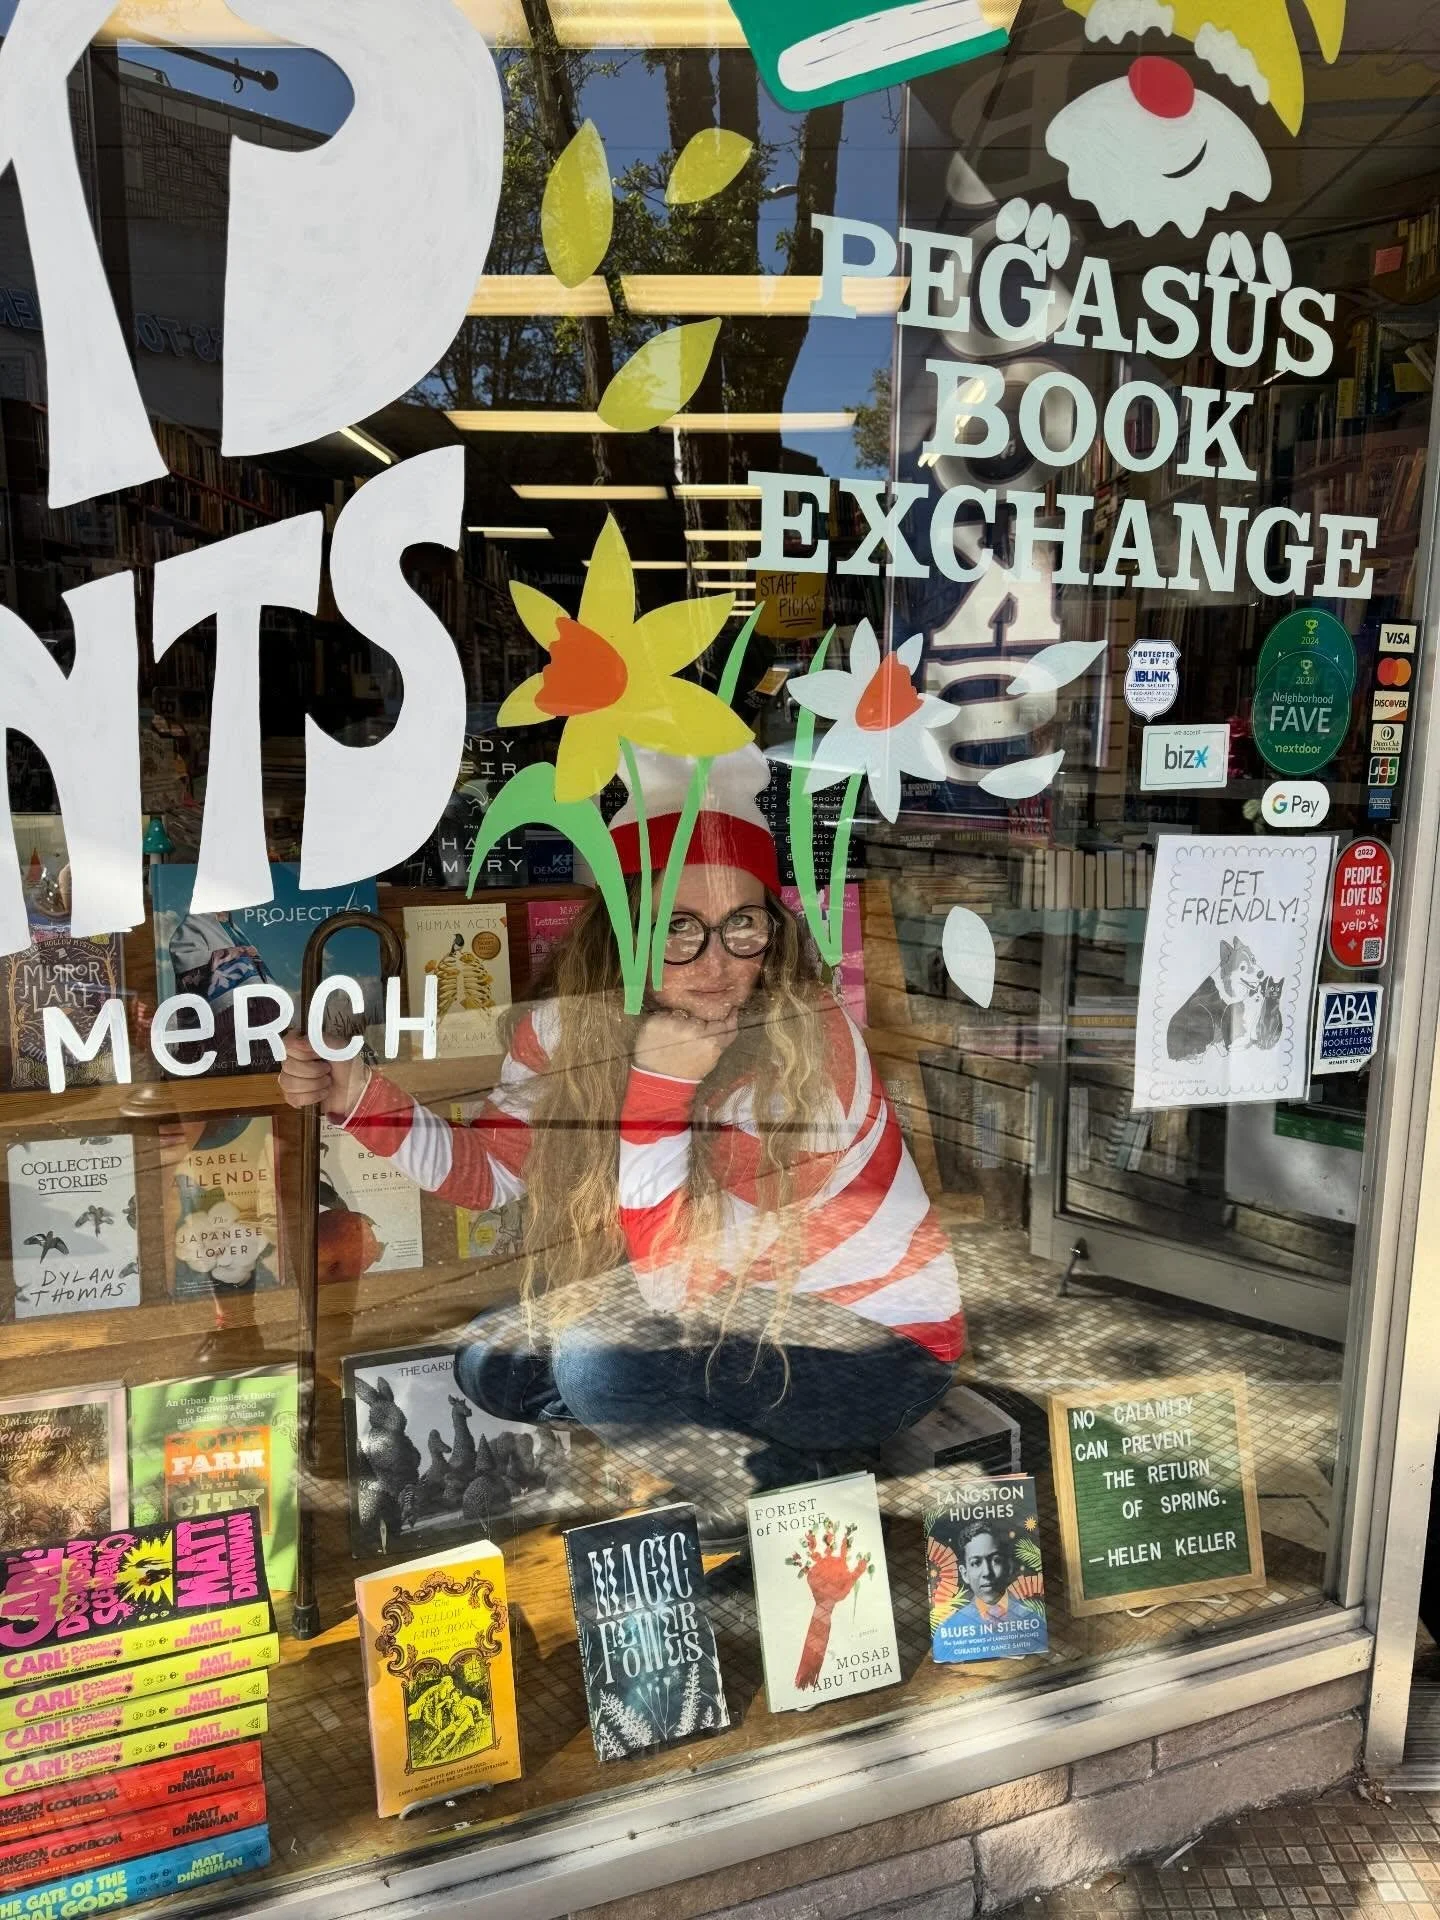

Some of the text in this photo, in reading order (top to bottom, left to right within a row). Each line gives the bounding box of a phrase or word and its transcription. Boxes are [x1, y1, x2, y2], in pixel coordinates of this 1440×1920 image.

[810, 212, 1336, 379] PEGASUS
[922, 358, 1257, 482] BOOK
[746, 470, 1379, 599] EXCHANGE
[760, 573, 800, 597] STAFF
[779, 589, 820, 617] PICKS
[1301, 636, 1320, 646] 2024
[1385, 631, 1411, 645] VISA
[1133, 650, 1175, 658] PROTECTED
[1149, 657, 1160, 665] BY
[1272, 691, 1334, 705] Neighborhood
[1374, 699, 1407, 709] DISCOVER
[1269, 705, 1332, 734] FAVE
[1274, 743, 1322, 754] nextdoor
[1370, 766, 1397, 776] JCB
[1291, 795, 1320, 818] Pay
[1357, 849, 1374, 857] 2023
[1220, 868, 1264, 897] PET
[1343, 866, 1383, 885] PEOPLE
[1340, 886, 1383, 907] LOVE US
[244, 906, 334, 924] PROJECT
[1180, 897, 1300, 926] FRIENDLY!
[1355, 908, 1366, 916] ON
[416, 917, 498, 931] HUMAN ACTS
[1340, 919, 1367, 934] yelp
[32, 981, 97, 1013] LAKE
[1325, 994, 1374, 1026] ABA
[1323, 1036, 1372, 1048] BOOKSELLERS
[1324, 1027, 1373, 1037] AMERICAN
[1322, 1046, 1371, 1057] ASSOCIATION
[21, 1156, 122, 1176] COLLECTED
[188, 1152, 248, 1167] ISABEL
[38, 1174, 109, 1191] STORIES
[171, 1168, 267, 1188] ALLENDE
[362, 1172, 402, 1181] DESIR
[178, 1227, 263, 1244] JAPANESE
[196, 1245, 249, 1259] LOVER
[42, 1267, 114, 1287] DYLAN
[30, 1282, 127, 1307] THOMAS
[399, 1361, 455, 1377] THE GARD
[166, 1399, 178, 1407] An
[180, 1398, 207, 1406] Urban
[235, 1402, 257, 1410] Food
[1072, 1397, 1194, 1430] NO CALAMITY
[230, 1411, 265, 1419] Animals
[1075, 1428, 1194, 1462] CAN PREVENT
[171, 1449, 265, 1476] FARM
[1103, 1457, 1210, 1490] THE RETURN
[172, 1488, 265, 1518] CITY
[936, 1485, 1025, 1507] LANGSTON
[1122, 1488, 1228, 1520] OF SPRING.
[755, 1498, 817, 1521] FOREST
[949, 1503, 1015, 1523] HUGHES
[756, 1512, 826, 1537] of NOISE
[1175, 1530, 1237, 1557] KELLER
[177, 1518, 230, 1608] MATT
[228, 1512, 259, 1600] DINNIMAN
[587, 1531, 693, 1620] MAGIC
[174, 1625, 242, 1648] DINNIMAN
[190, 1618, 222, 1634] MATT
[940, 1618, 1040, 1639] BLUES IN STEREO
[3, 1637, 123, 1679] CARL'S DOOMSDAY
[200, 1651, 233, 1668] MATT
[836, 1646, 891, 1670] MOSAB
[982, 1645, 990, 1653] BY
[185, 1657, 252, 1682] DINNIMAN
[812, 1661, 894, 1693] ABU TOHA
[15, 1672, 134, 1718] CARL'S DOOMSDAY
[174, 1693, 241, 1716] DINNIMAN
[188, 1687, 222, 1704] MATT
[4, 1717, 70, 1750] CARL'S
[71, 1706, 124, 1723] DOOMSDAY
[188, 1721, 222, 1738] MATT
[173, 1727, 241, 1752] DINNIMAN
[4, 1753, 70, 1787] CARL'S
[71, 1741, 124, 1761] DOOMSDAY
[182, 1764, 216, 1781] MATT
[167, 1770, 235, 1795] DINNIMAN
[46, 1787, 119, 1812] COOKBOOK
[172, 1811, 239, 1837] DINNIMAN
[186, 1805, 221, 1823] MATT
[51, 1831, 123, 1859] COOKBOOK
[177, 1855, 243, 1884] DINNIMAN
[190, 1851, 226, 1871] MATT
[26, 1869, 128, 1912] GATE OF THE
[60, 1886, 129, 1920] GODS
